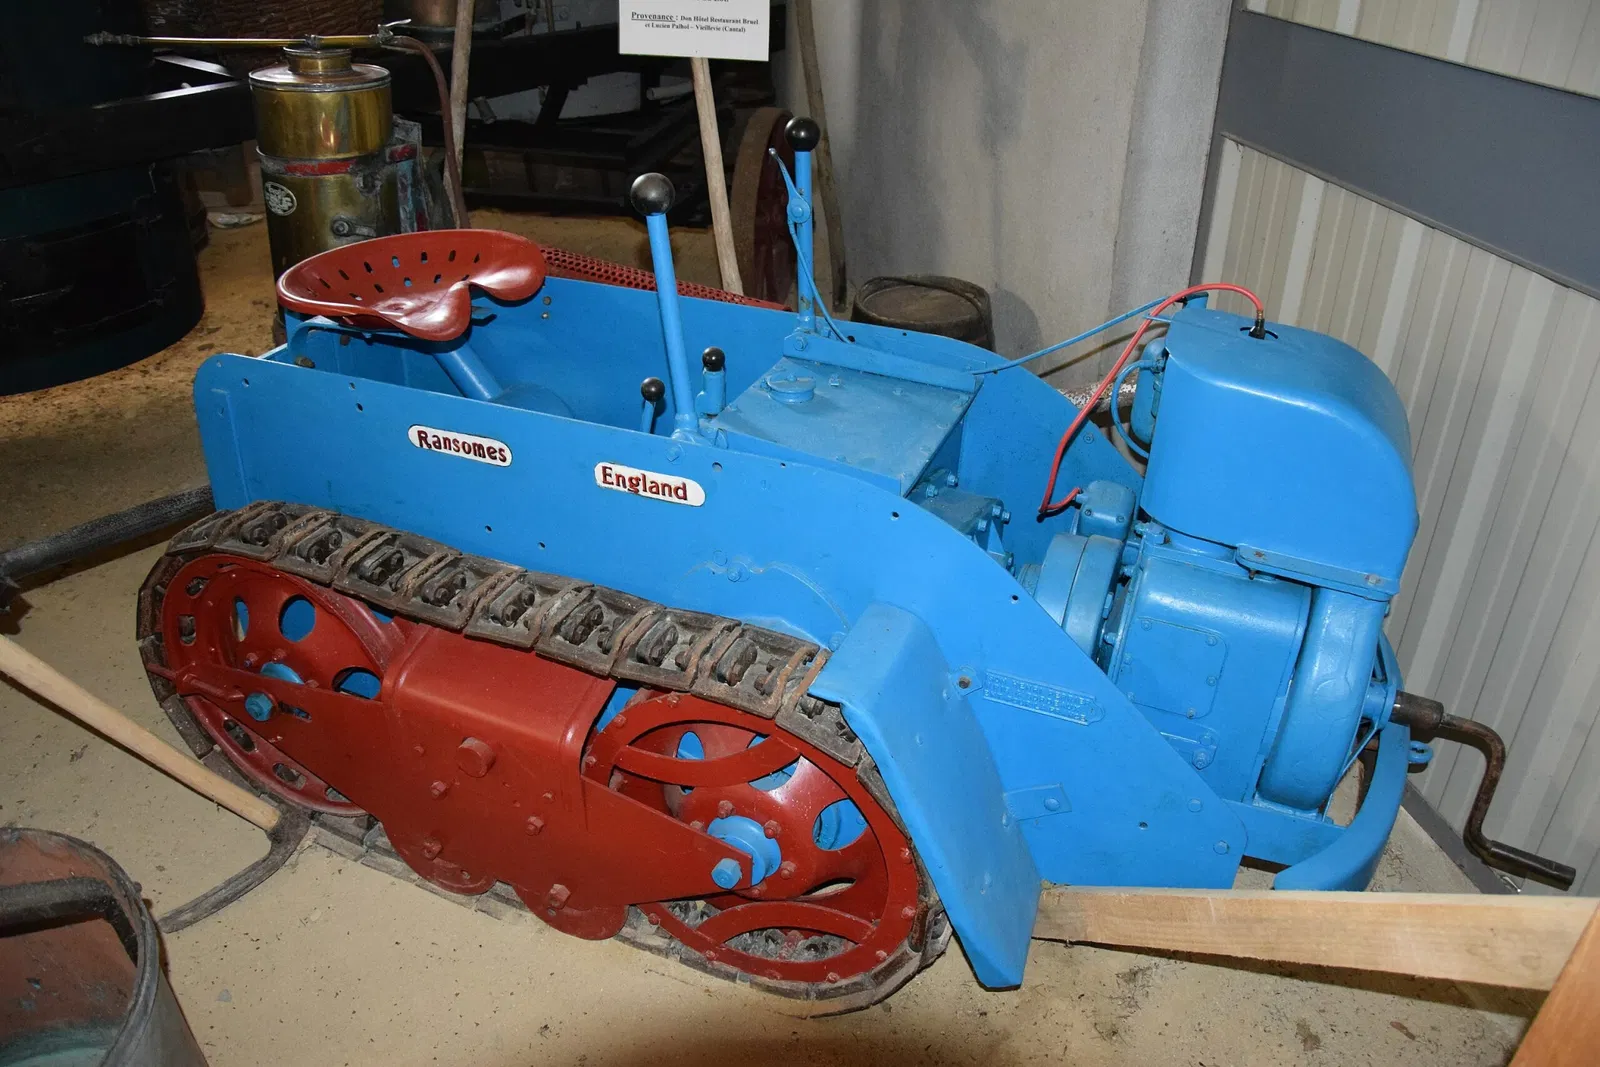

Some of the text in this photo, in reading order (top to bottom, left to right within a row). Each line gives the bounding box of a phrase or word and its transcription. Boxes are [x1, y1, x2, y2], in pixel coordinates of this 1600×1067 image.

[631, 11, 674, 22] Provenance
[693, 15, 709, 23] Hôtel
[722, 25, 746, 33] (Cantal)
[417, 430, 508, 463] Ransomes
[601, 465, 688, 502] England
